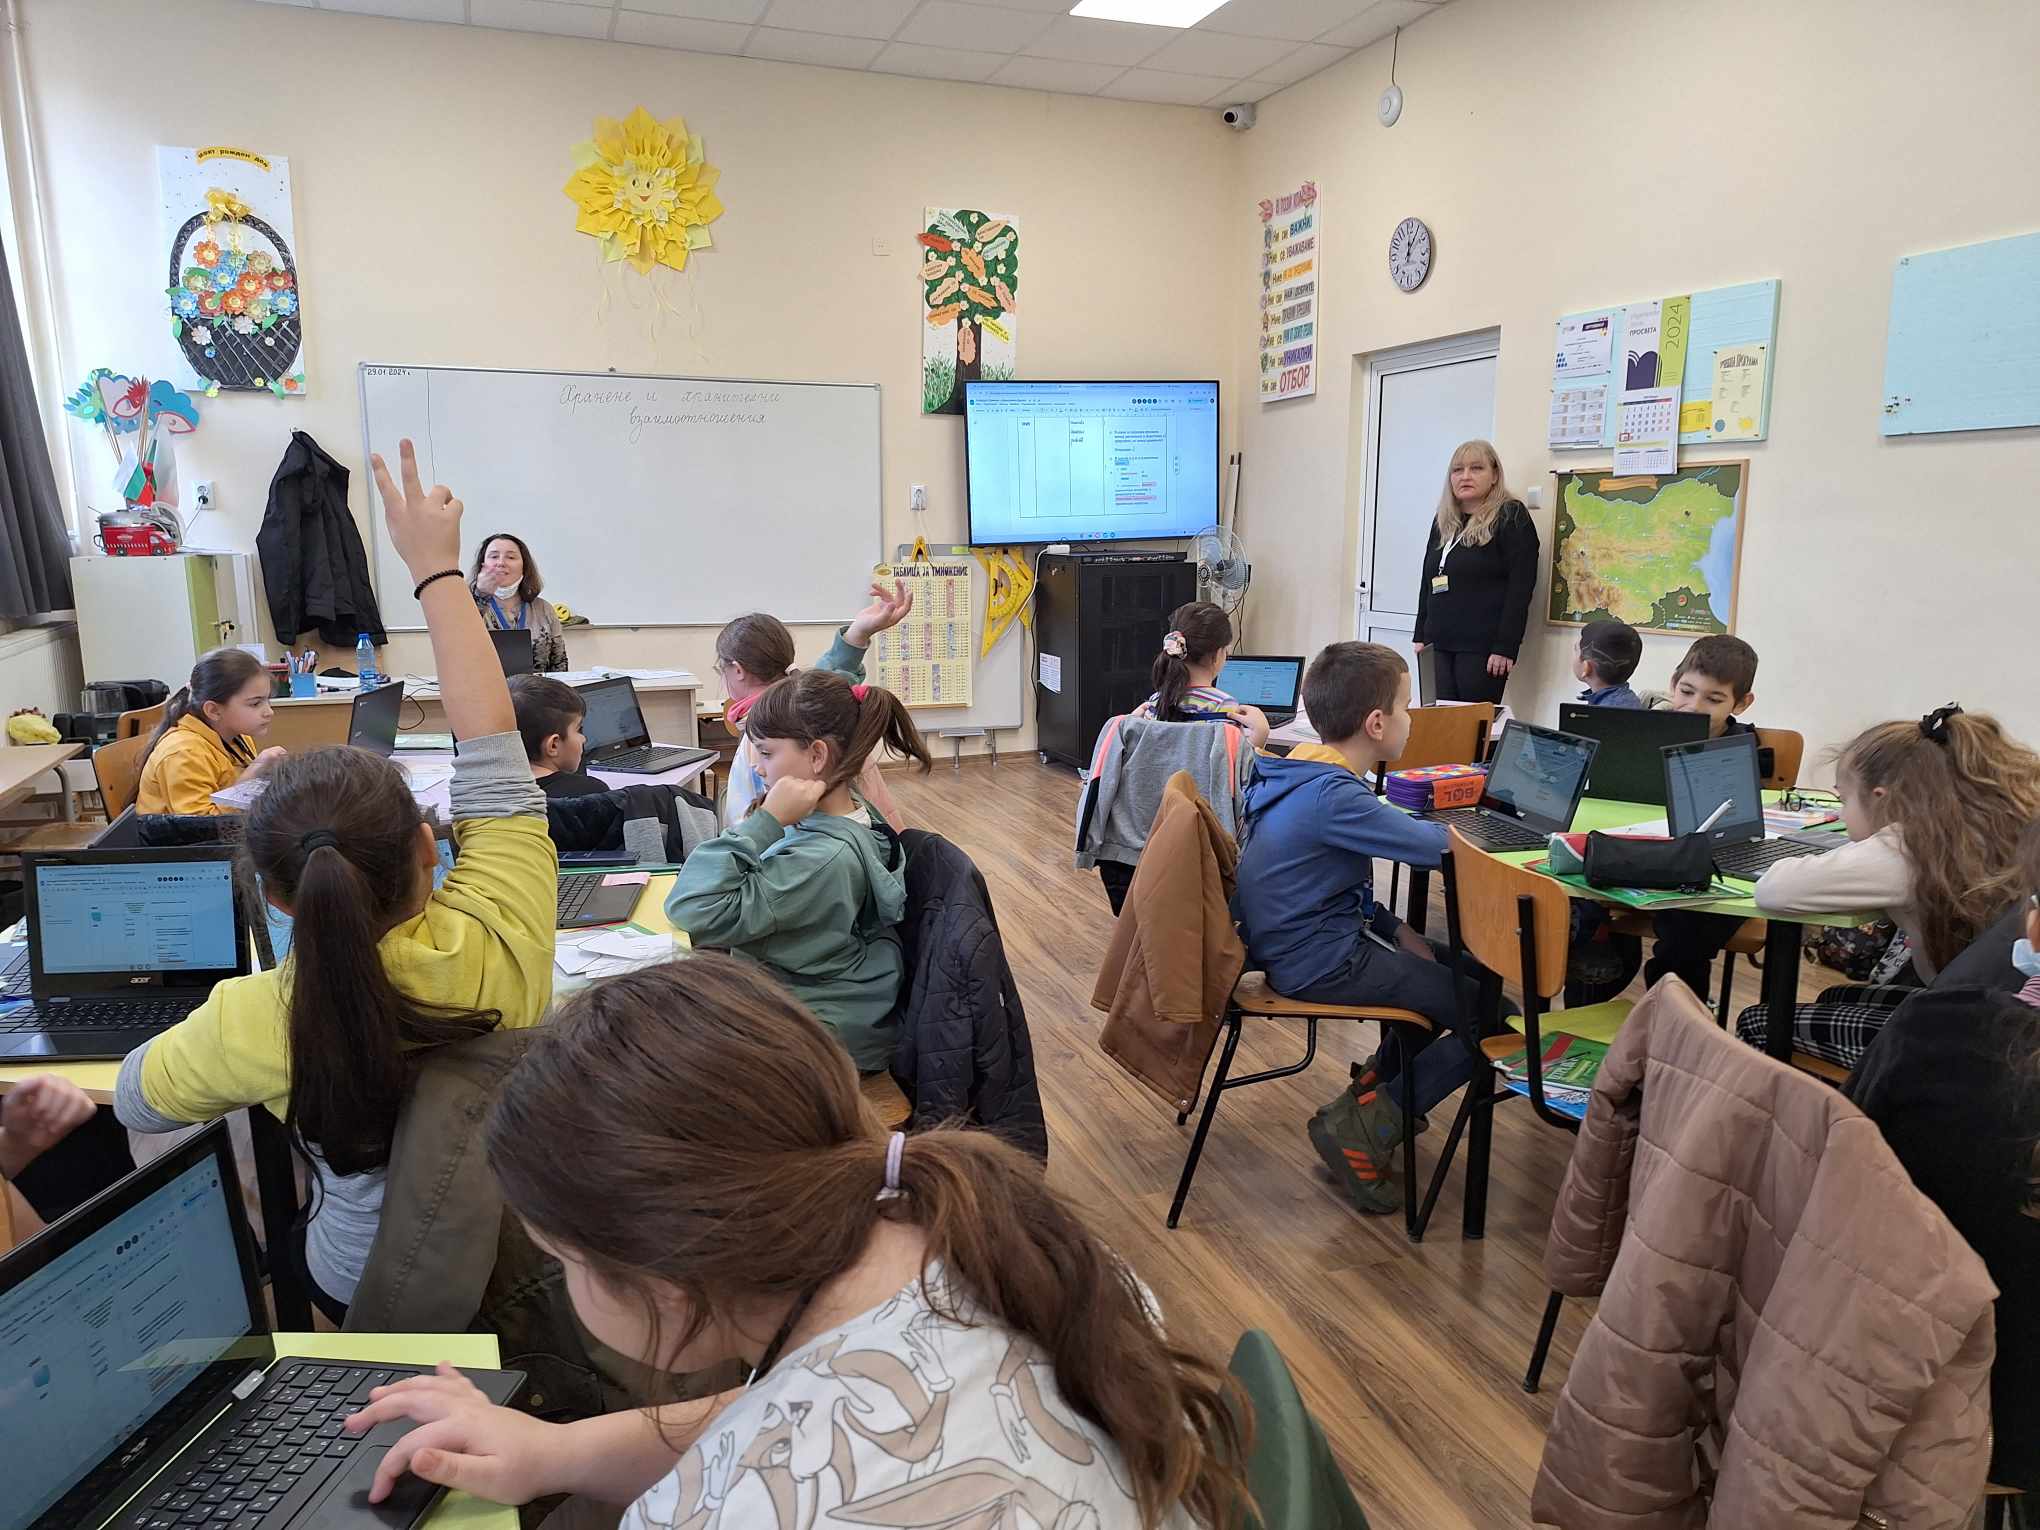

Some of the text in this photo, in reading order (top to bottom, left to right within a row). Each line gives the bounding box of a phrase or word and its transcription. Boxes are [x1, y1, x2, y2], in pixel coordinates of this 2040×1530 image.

[1665, 303, 1683, 353] 2024
[1280, 365, 1310, 393] ОТБОР
[646, 391, 657, 402] и
[893, 565, 920, 577] ТАБЛИЦА
[931, 565, 968, 577] УМНОЖЕНИЕ
[130, 976, 152, 984] acer
